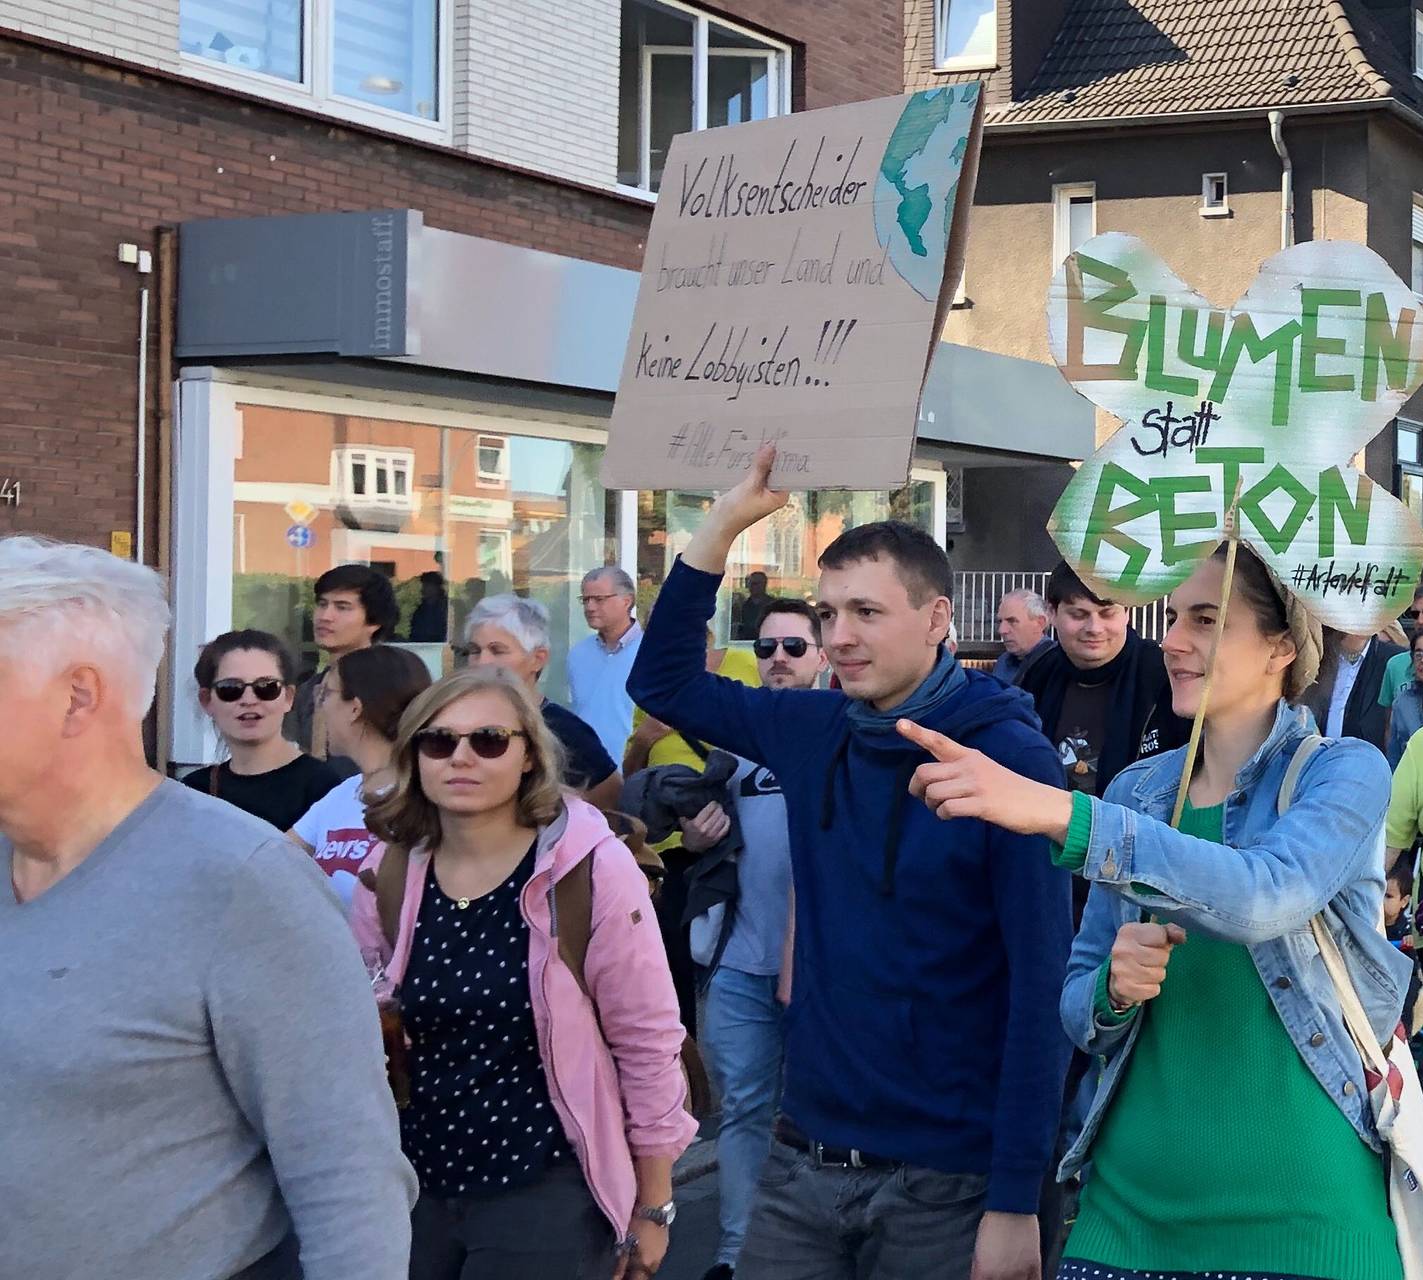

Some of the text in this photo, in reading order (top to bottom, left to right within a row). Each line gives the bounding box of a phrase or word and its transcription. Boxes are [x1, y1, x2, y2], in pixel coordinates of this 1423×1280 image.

[679, 136, 867, 219] Volksentscheider
[656, 226, 891, 292] braucht unser Land und
[1064, 252, 1416, 427] BLUMEN
[1079, 446, 1373, 588] BETON
